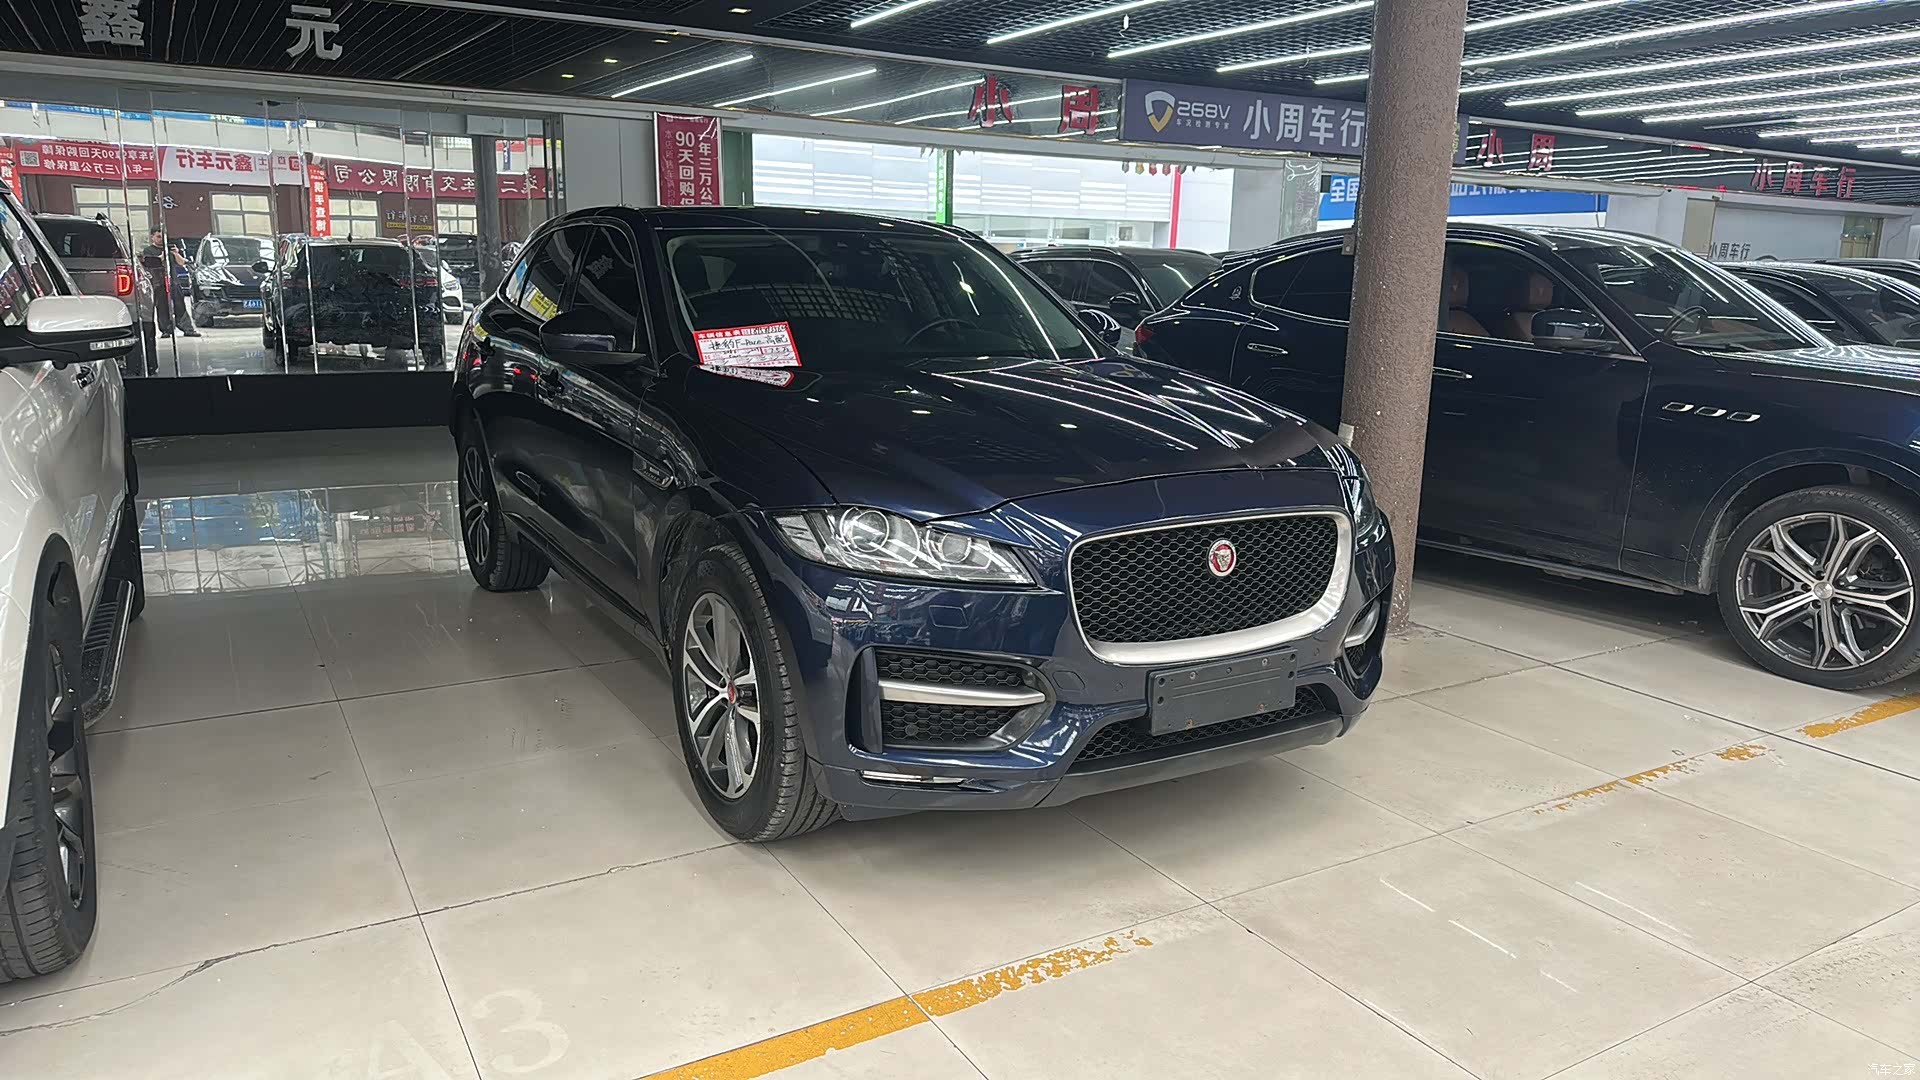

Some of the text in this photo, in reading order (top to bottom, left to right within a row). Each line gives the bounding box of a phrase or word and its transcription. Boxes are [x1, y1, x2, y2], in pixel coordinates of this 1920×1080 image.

[1177, 101, 1231, 120] 268V
[1243, 100, 1365, 148] 小周车行
[698, 134, 713, 205] 一年三万公
[1751, 158, 1857, 199] 小周车行
[1709, 242, 1751, 260] 小周车行
